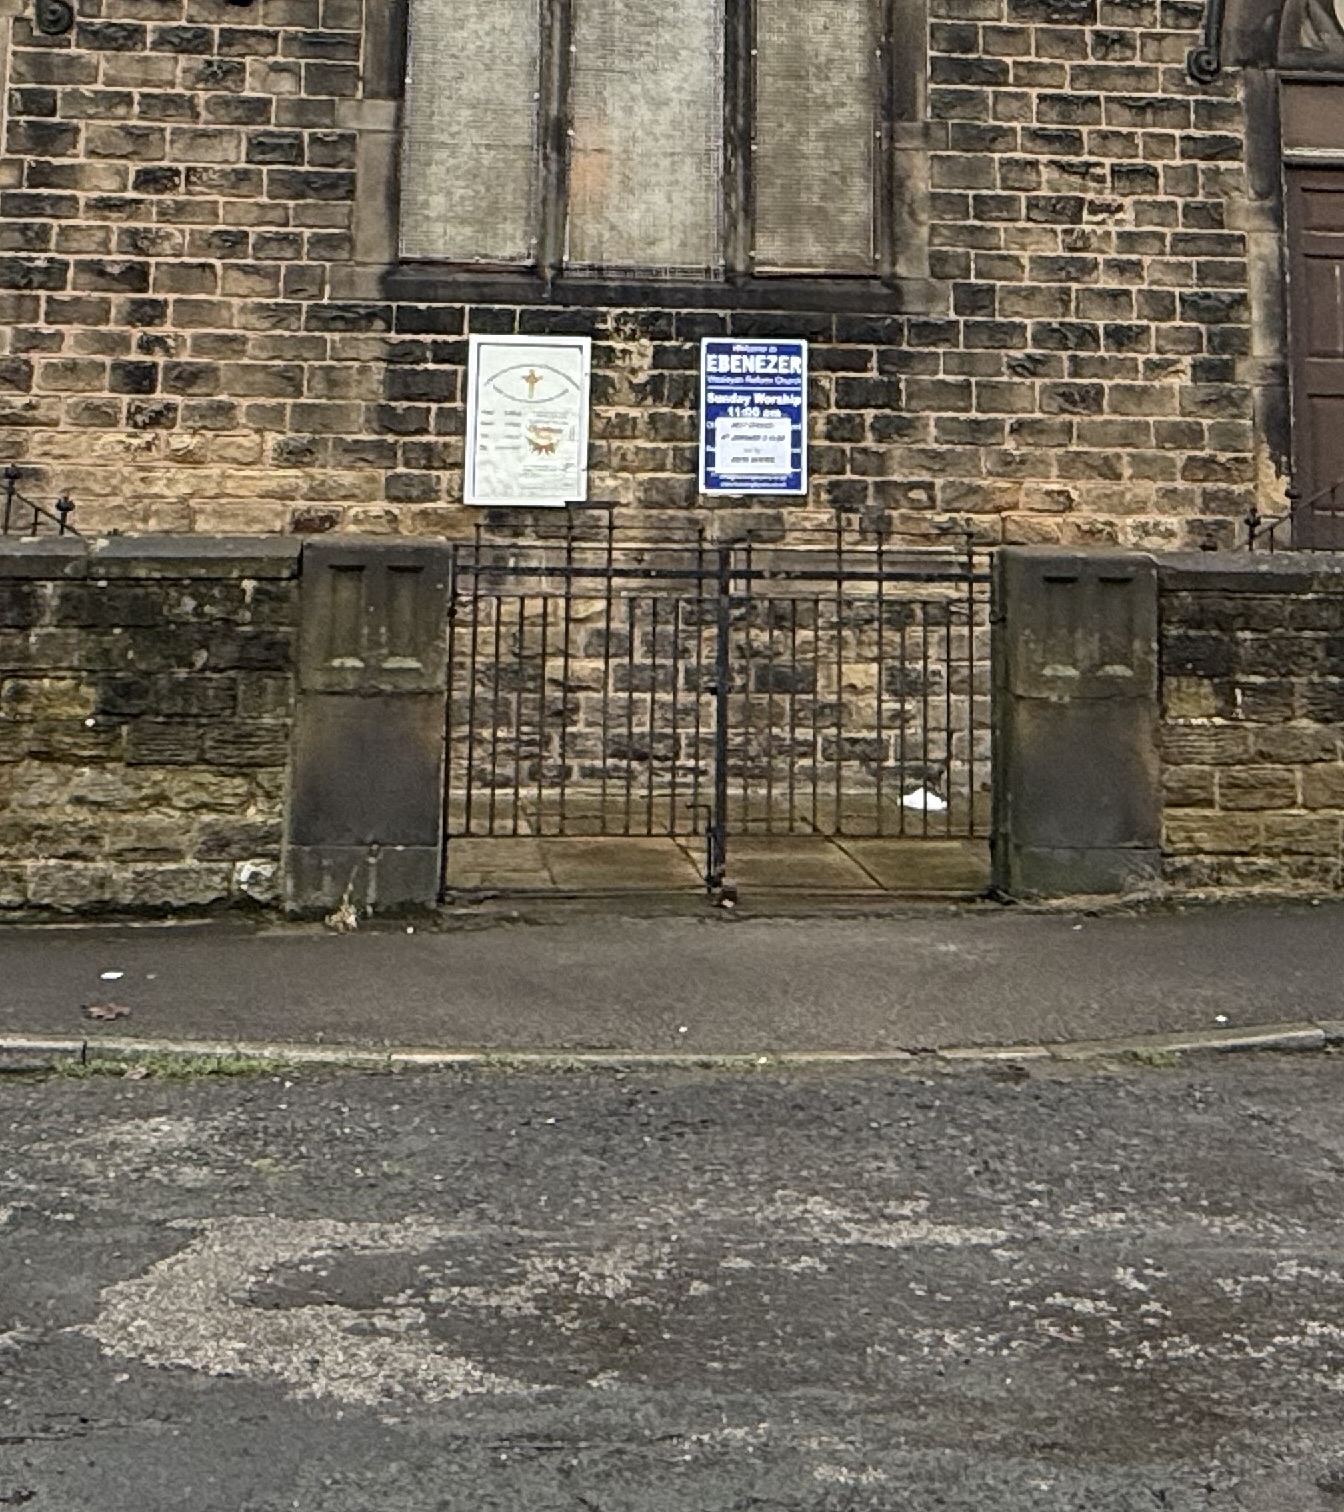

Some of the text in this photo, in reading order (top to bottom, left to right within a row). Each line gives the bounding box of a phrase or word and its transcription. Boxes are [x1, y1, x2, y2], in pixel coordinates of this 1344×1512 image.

[706, 354, 802, 374] EBENEZER
[706, 392, 802, 408] Sunday Worship
